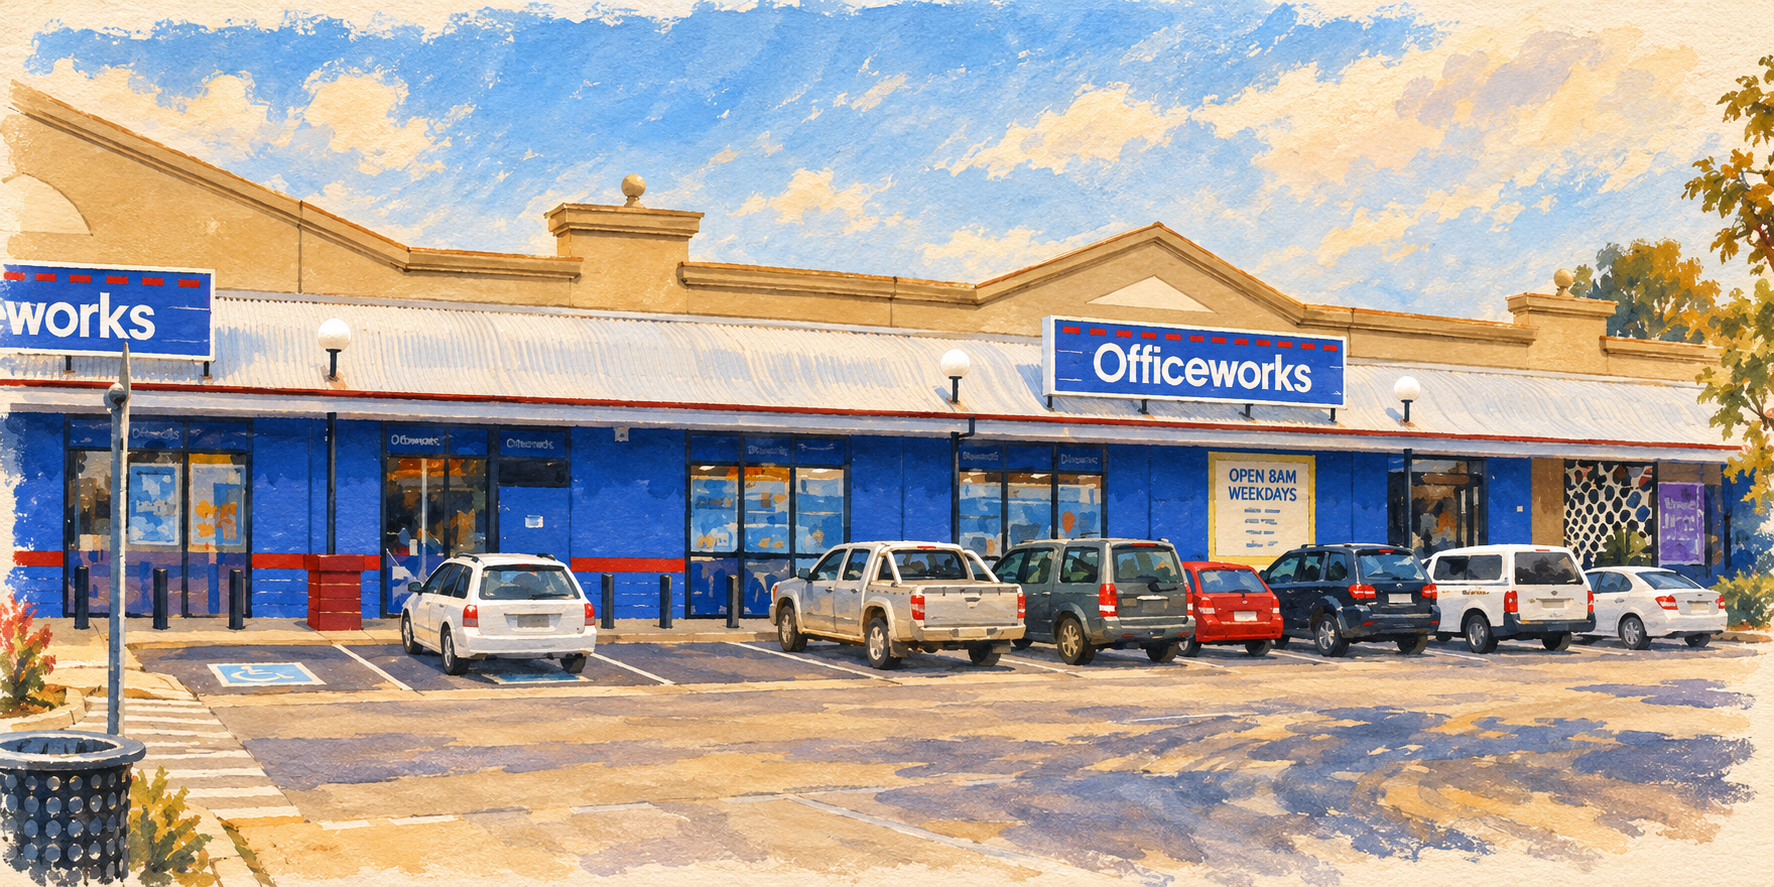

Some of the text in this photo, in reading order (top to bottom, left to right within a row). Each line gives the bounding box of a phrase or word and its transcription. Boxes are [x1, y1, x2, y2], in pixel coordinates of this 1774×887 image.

[0, 292, 156, 340] works
[1093, 342, 1312, 393] Officeworks
[1229, 468, 1297, 484] OPEN 8AM
[1228, 486, 1297, 502] WEEKDAYS
